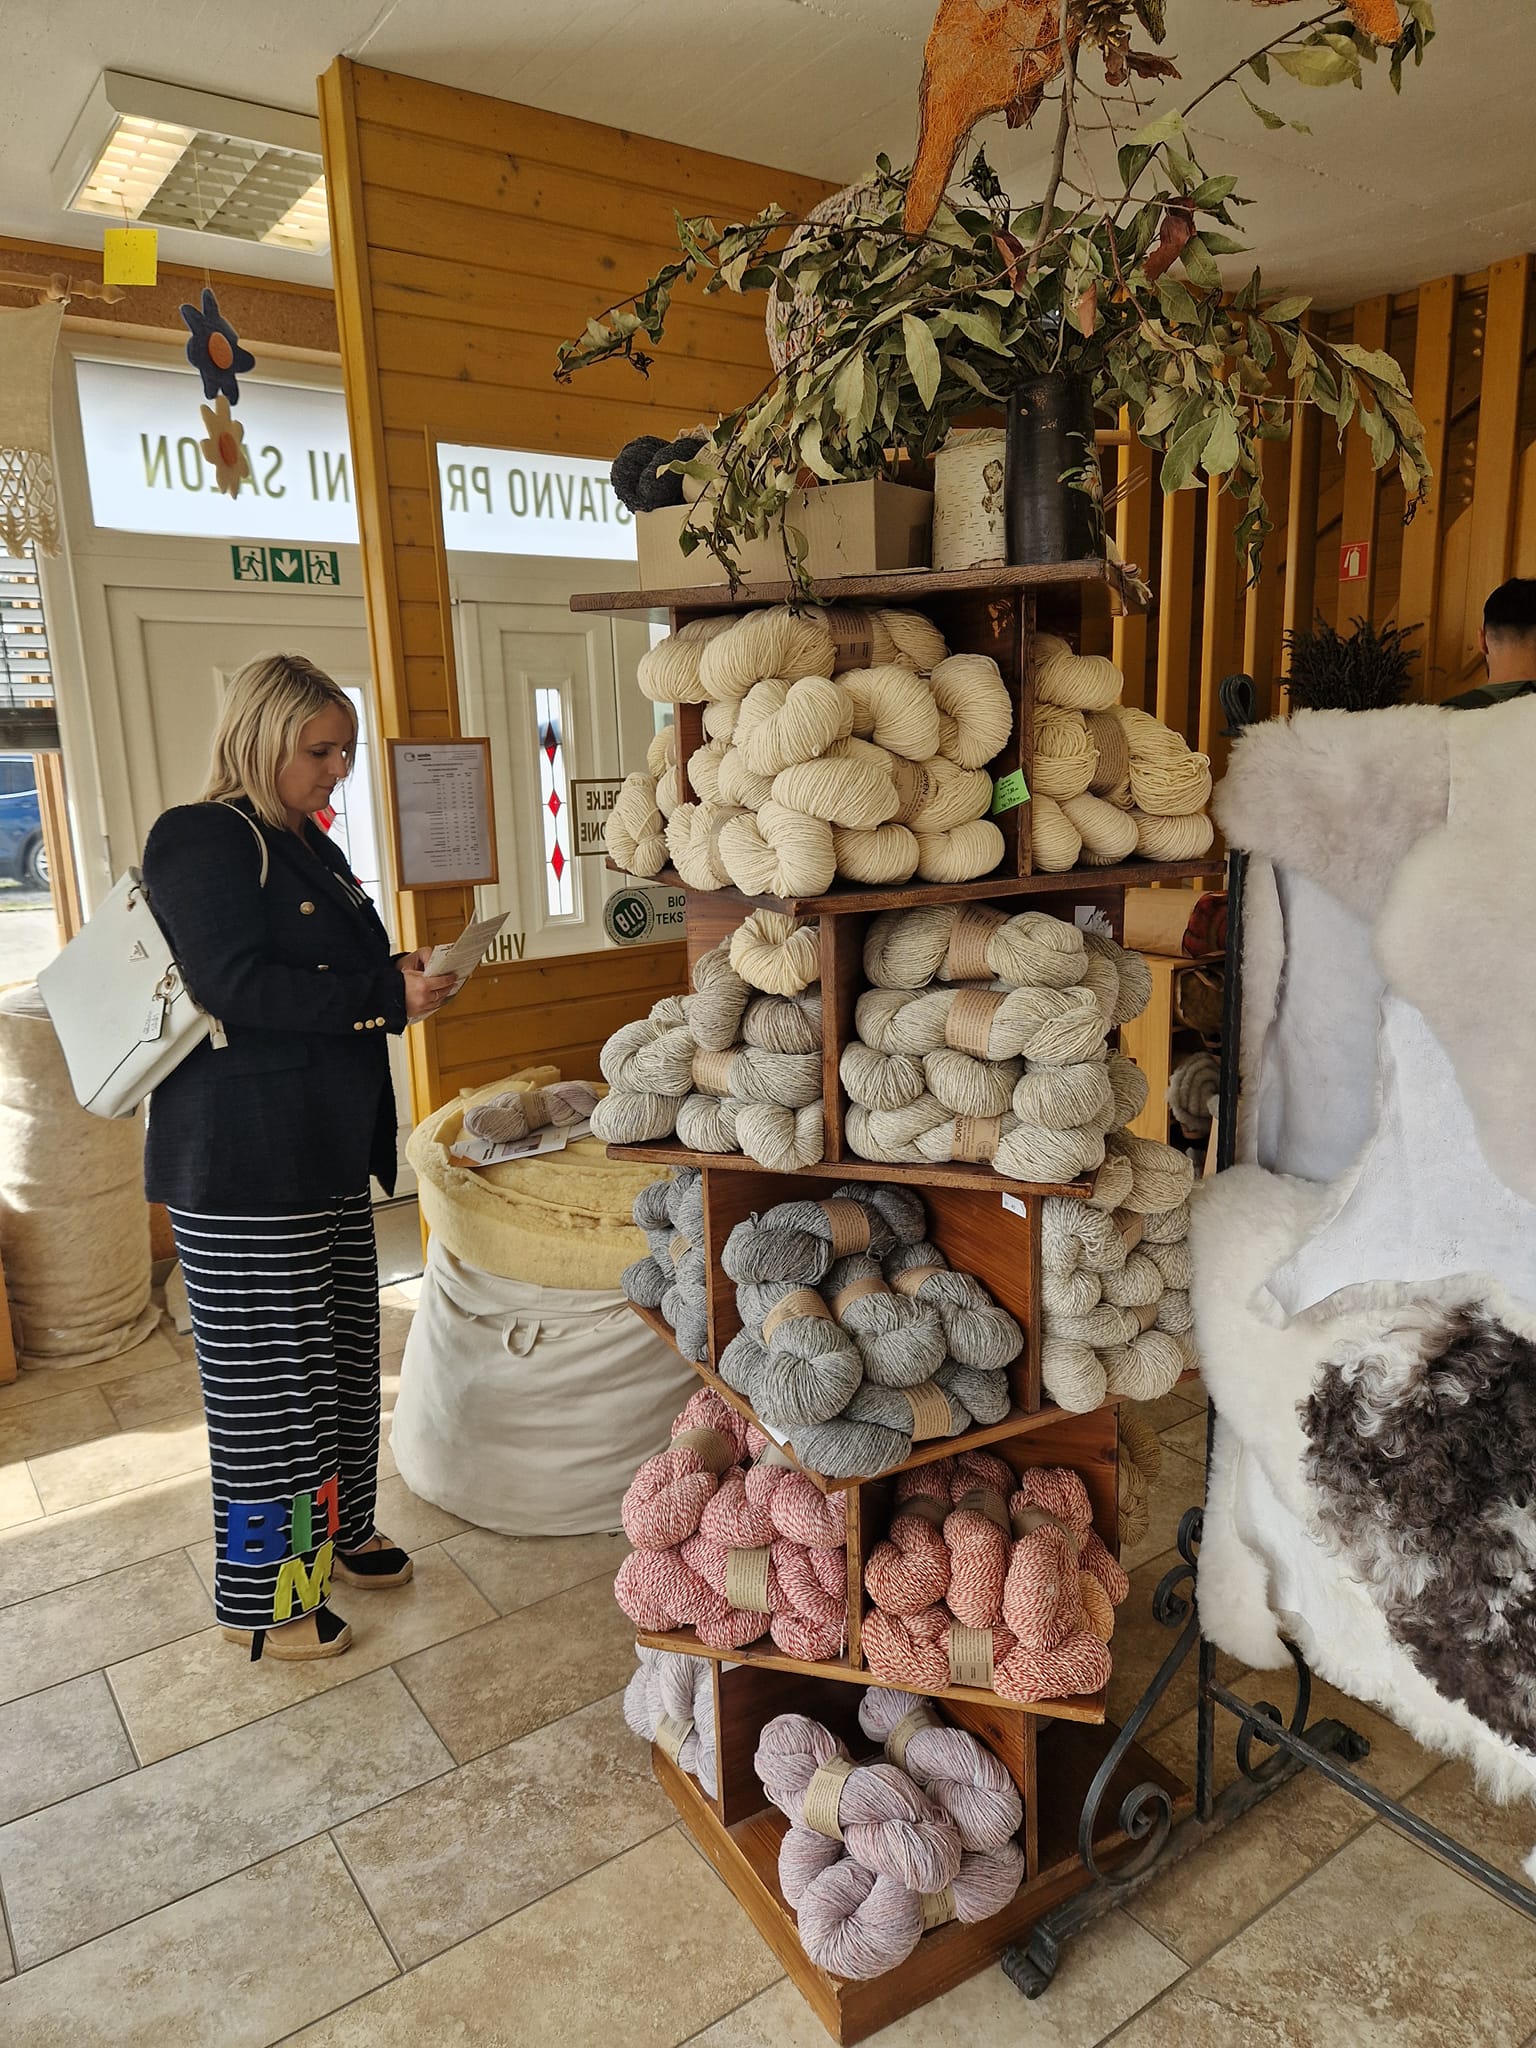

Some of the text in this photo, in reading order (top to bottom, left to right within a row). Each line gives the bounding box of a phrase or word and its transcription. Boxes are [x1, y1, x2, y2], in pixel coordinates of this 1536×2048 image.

[667, 895, 686, 908] BIO
[615, 902, 644, 932] BIO
[655, 911, 686, 925] TEKS
[954, 1117, 963, 1143] SOVEN
